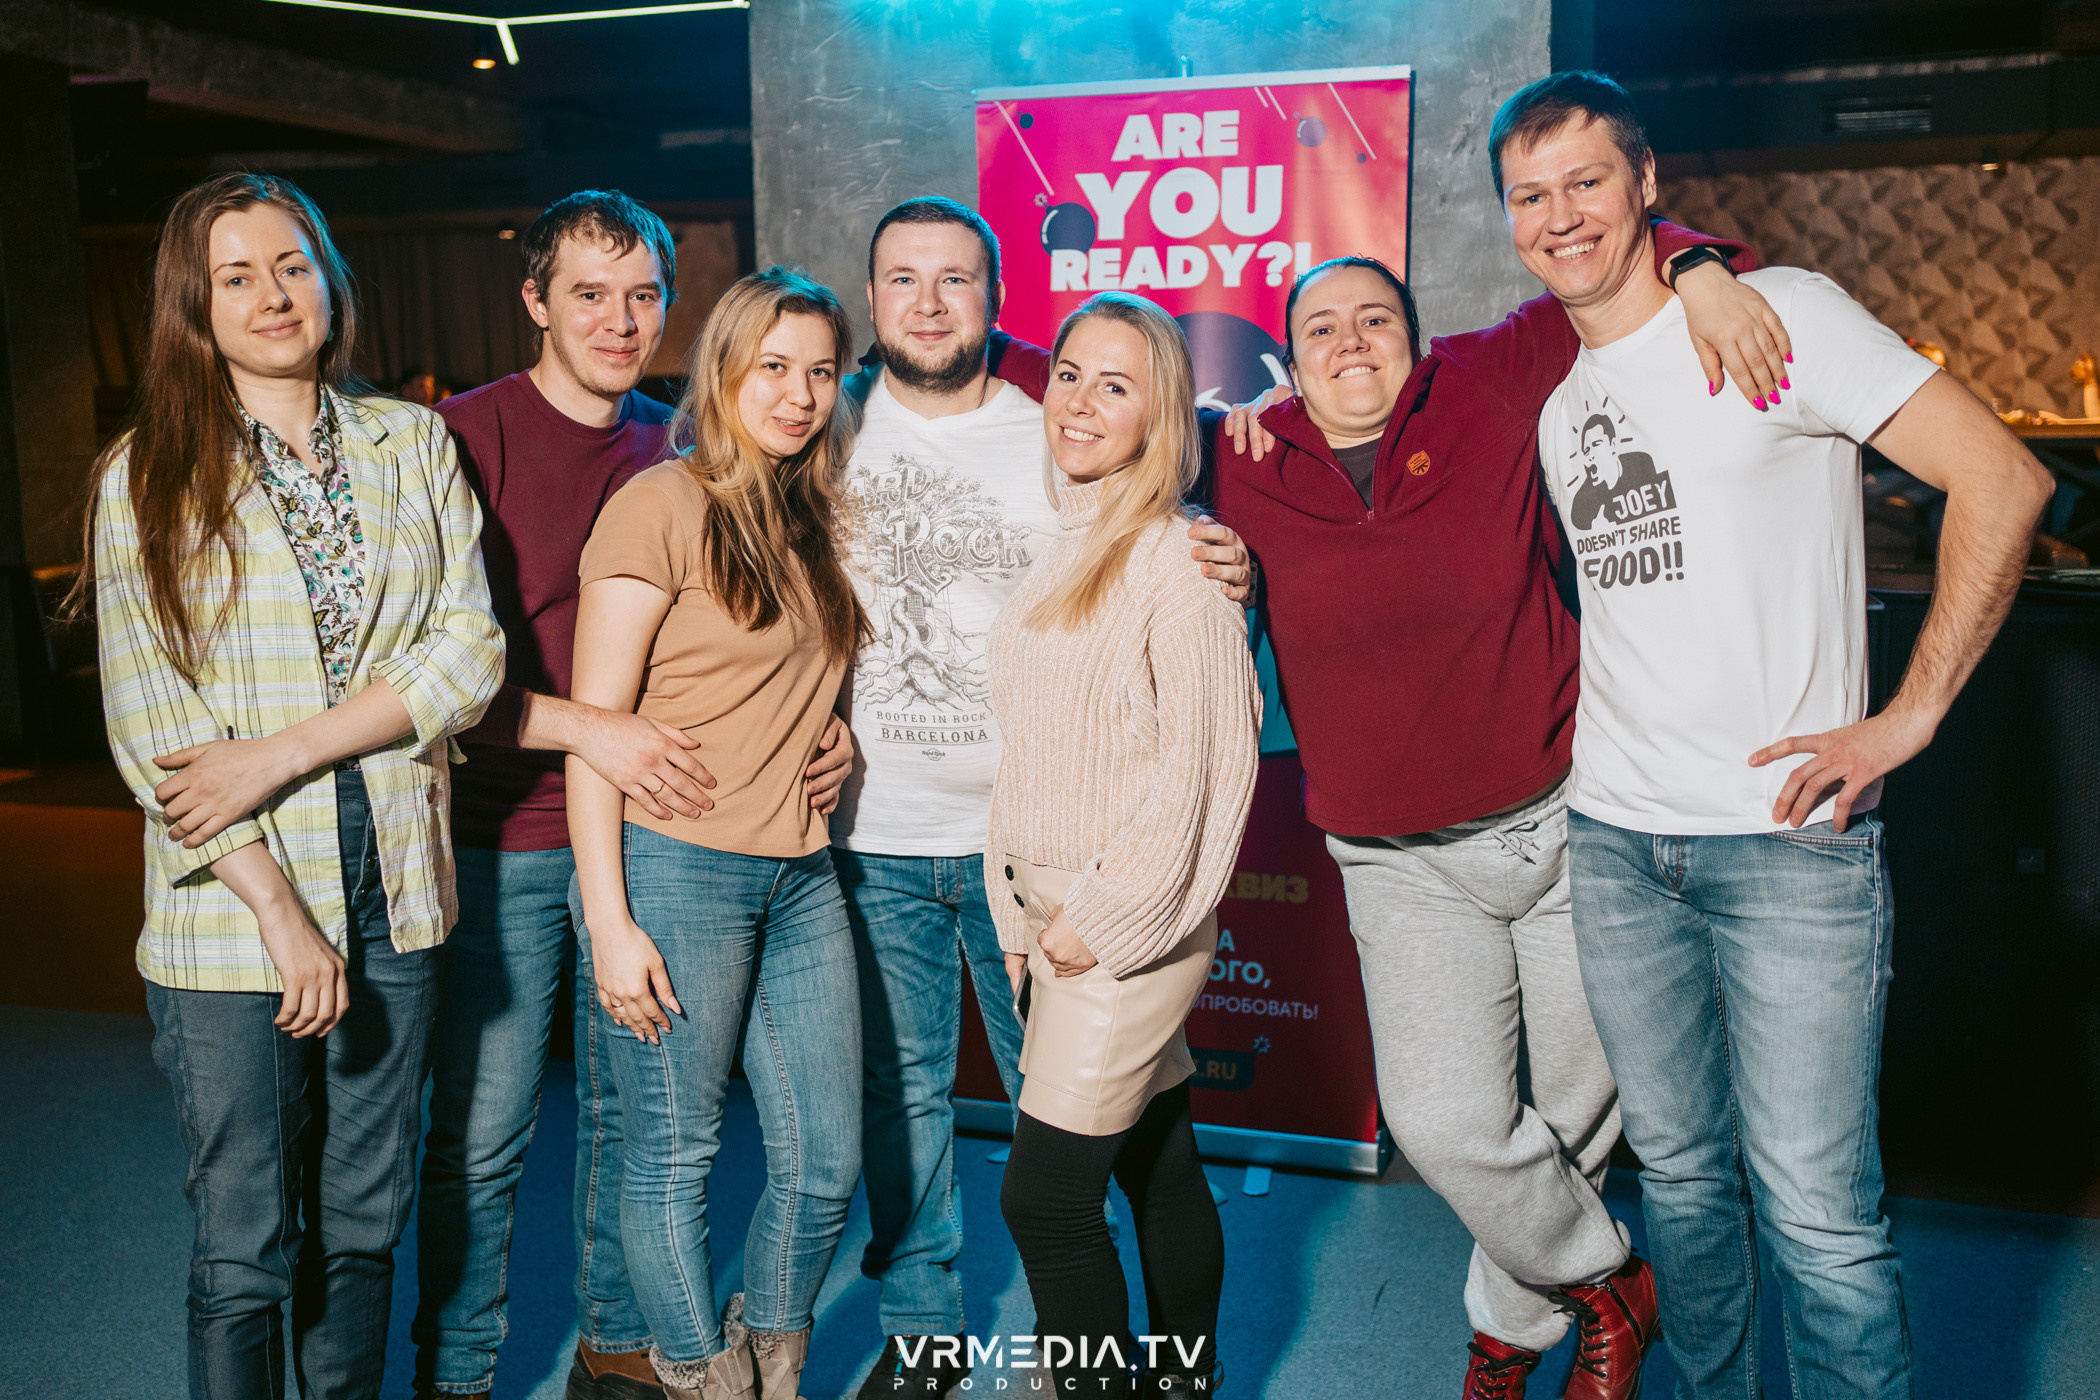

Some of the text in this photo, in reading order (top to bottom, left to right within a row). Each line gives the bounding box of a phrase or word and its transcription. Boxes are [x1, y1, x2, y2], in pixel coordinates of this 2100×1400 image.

[1111, 110, 1240, 162] ARE
[1075, 165, 1284, 240] YOU
[1050, 241, 1312, 292] READY?!
[839, 463, 935, 513] ARD
[1612, 480, 1669, 520] JOEY
[1576, 516, 1682, 555] DOESN'T SHARE
[1583, 540, 1685, 590] FOOD!!
[876, 711, 987, 724] ROOTED IN ROCK
[881, 727, 989, 743] BARCELONA
